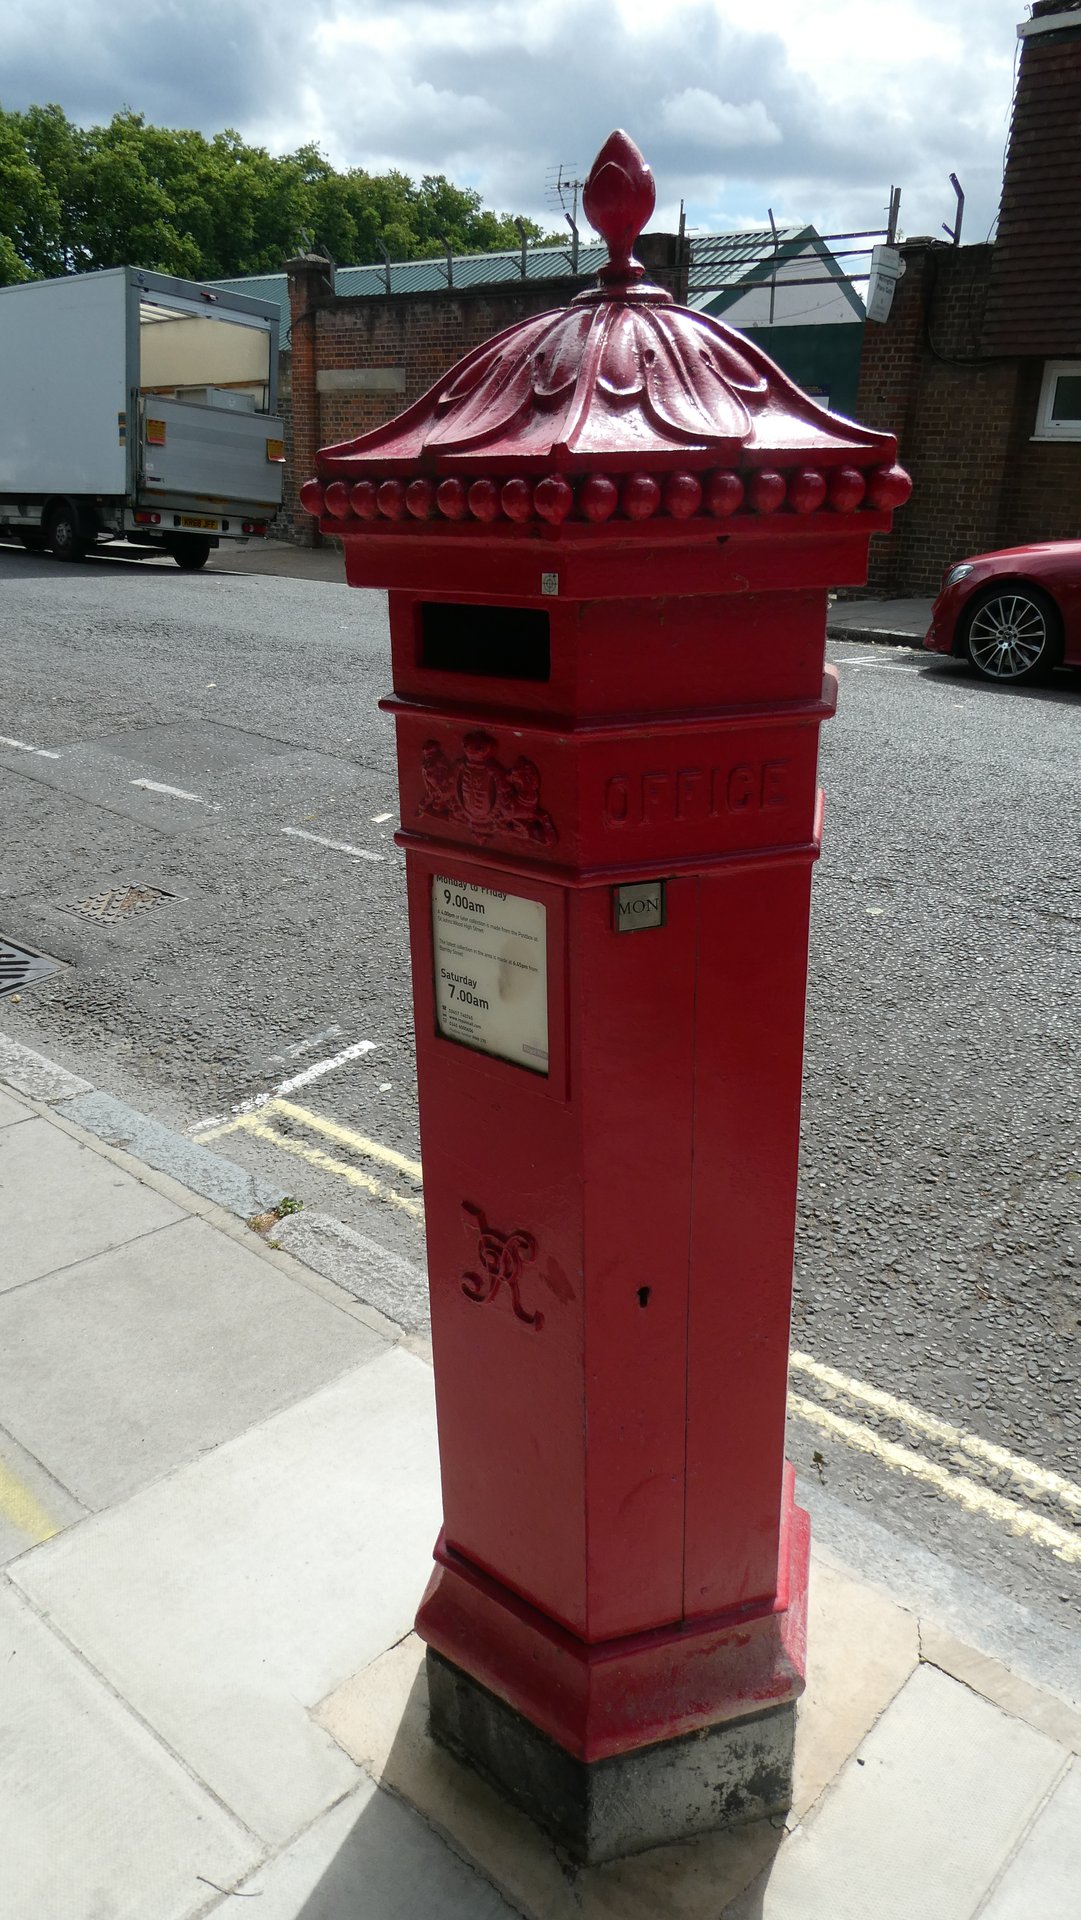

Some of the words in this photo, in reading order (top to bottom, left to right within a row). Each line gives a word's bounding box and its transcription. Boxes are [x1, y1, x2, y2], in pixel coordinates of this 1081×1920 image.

[604, 760, 789, 827] OFFICE
[437, 875, 468, 891] Monday
[470, 883, 479, 892] to
[443, 889, 485, 914] 9.00am
[618, 897, 660, 917] MON
[463, 922, 472, 931] High
[468, 917, 486, 927] collection
[501, 926, 511, 934] from
[441, 968, 477, 989] Saturday
[448, 983, 489, 1010] 7.00am
